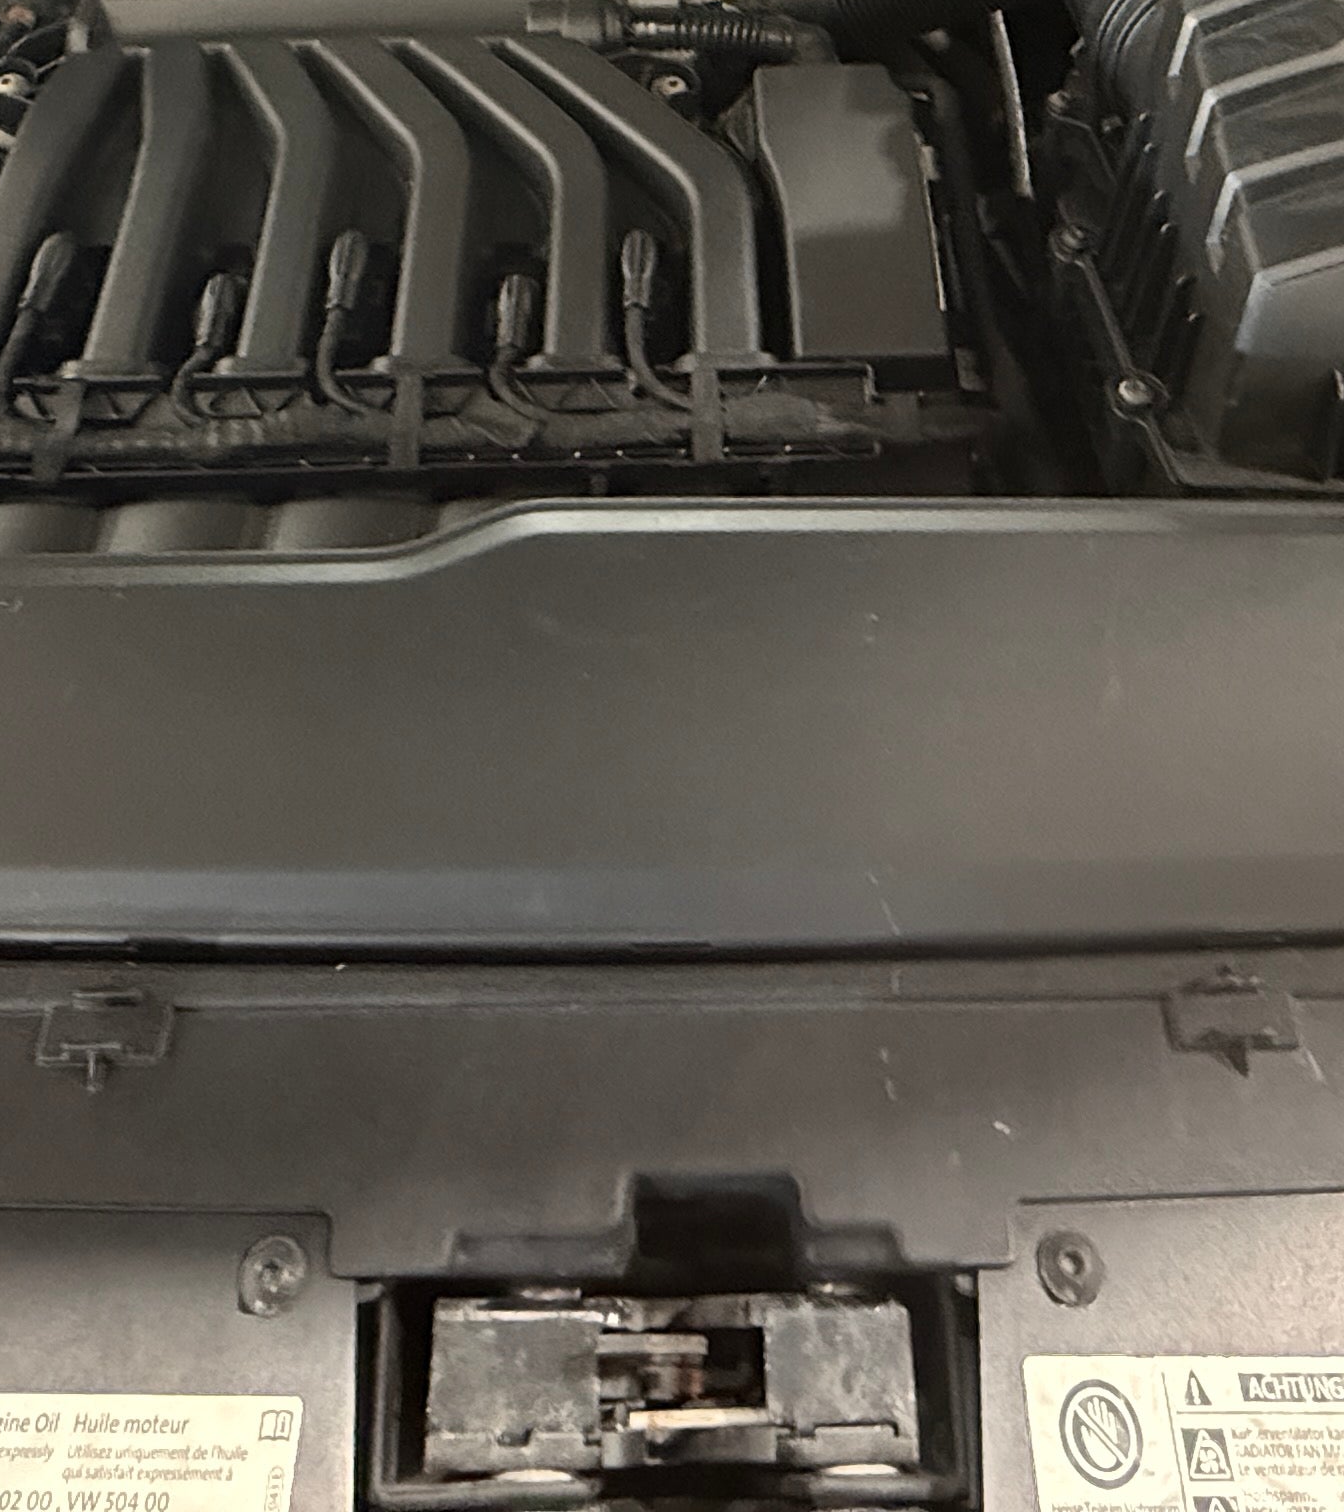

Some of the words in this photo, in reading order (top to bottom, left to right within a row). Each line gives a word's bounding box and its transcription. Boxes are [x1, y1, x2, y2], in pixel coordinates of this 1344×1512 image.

[34, 1411, 61, 1433] Oil
[72, 1412, 120, 1434] Huile
[123, 1414, 190, 1434] moteur
[67, 1444, 113, 1460] Utilisez
[114, 1445, 190, 1464] uniquement
[191, 1445, 209, 1460] de
[61, 1465, 83, 1484] qui
[84, 1465, 135, 1481] satisfait
[67, 1490, 102, 1512] VW
[105, 1491, 139, 1512] 504
[144, 1491, 170, 1512] 00
